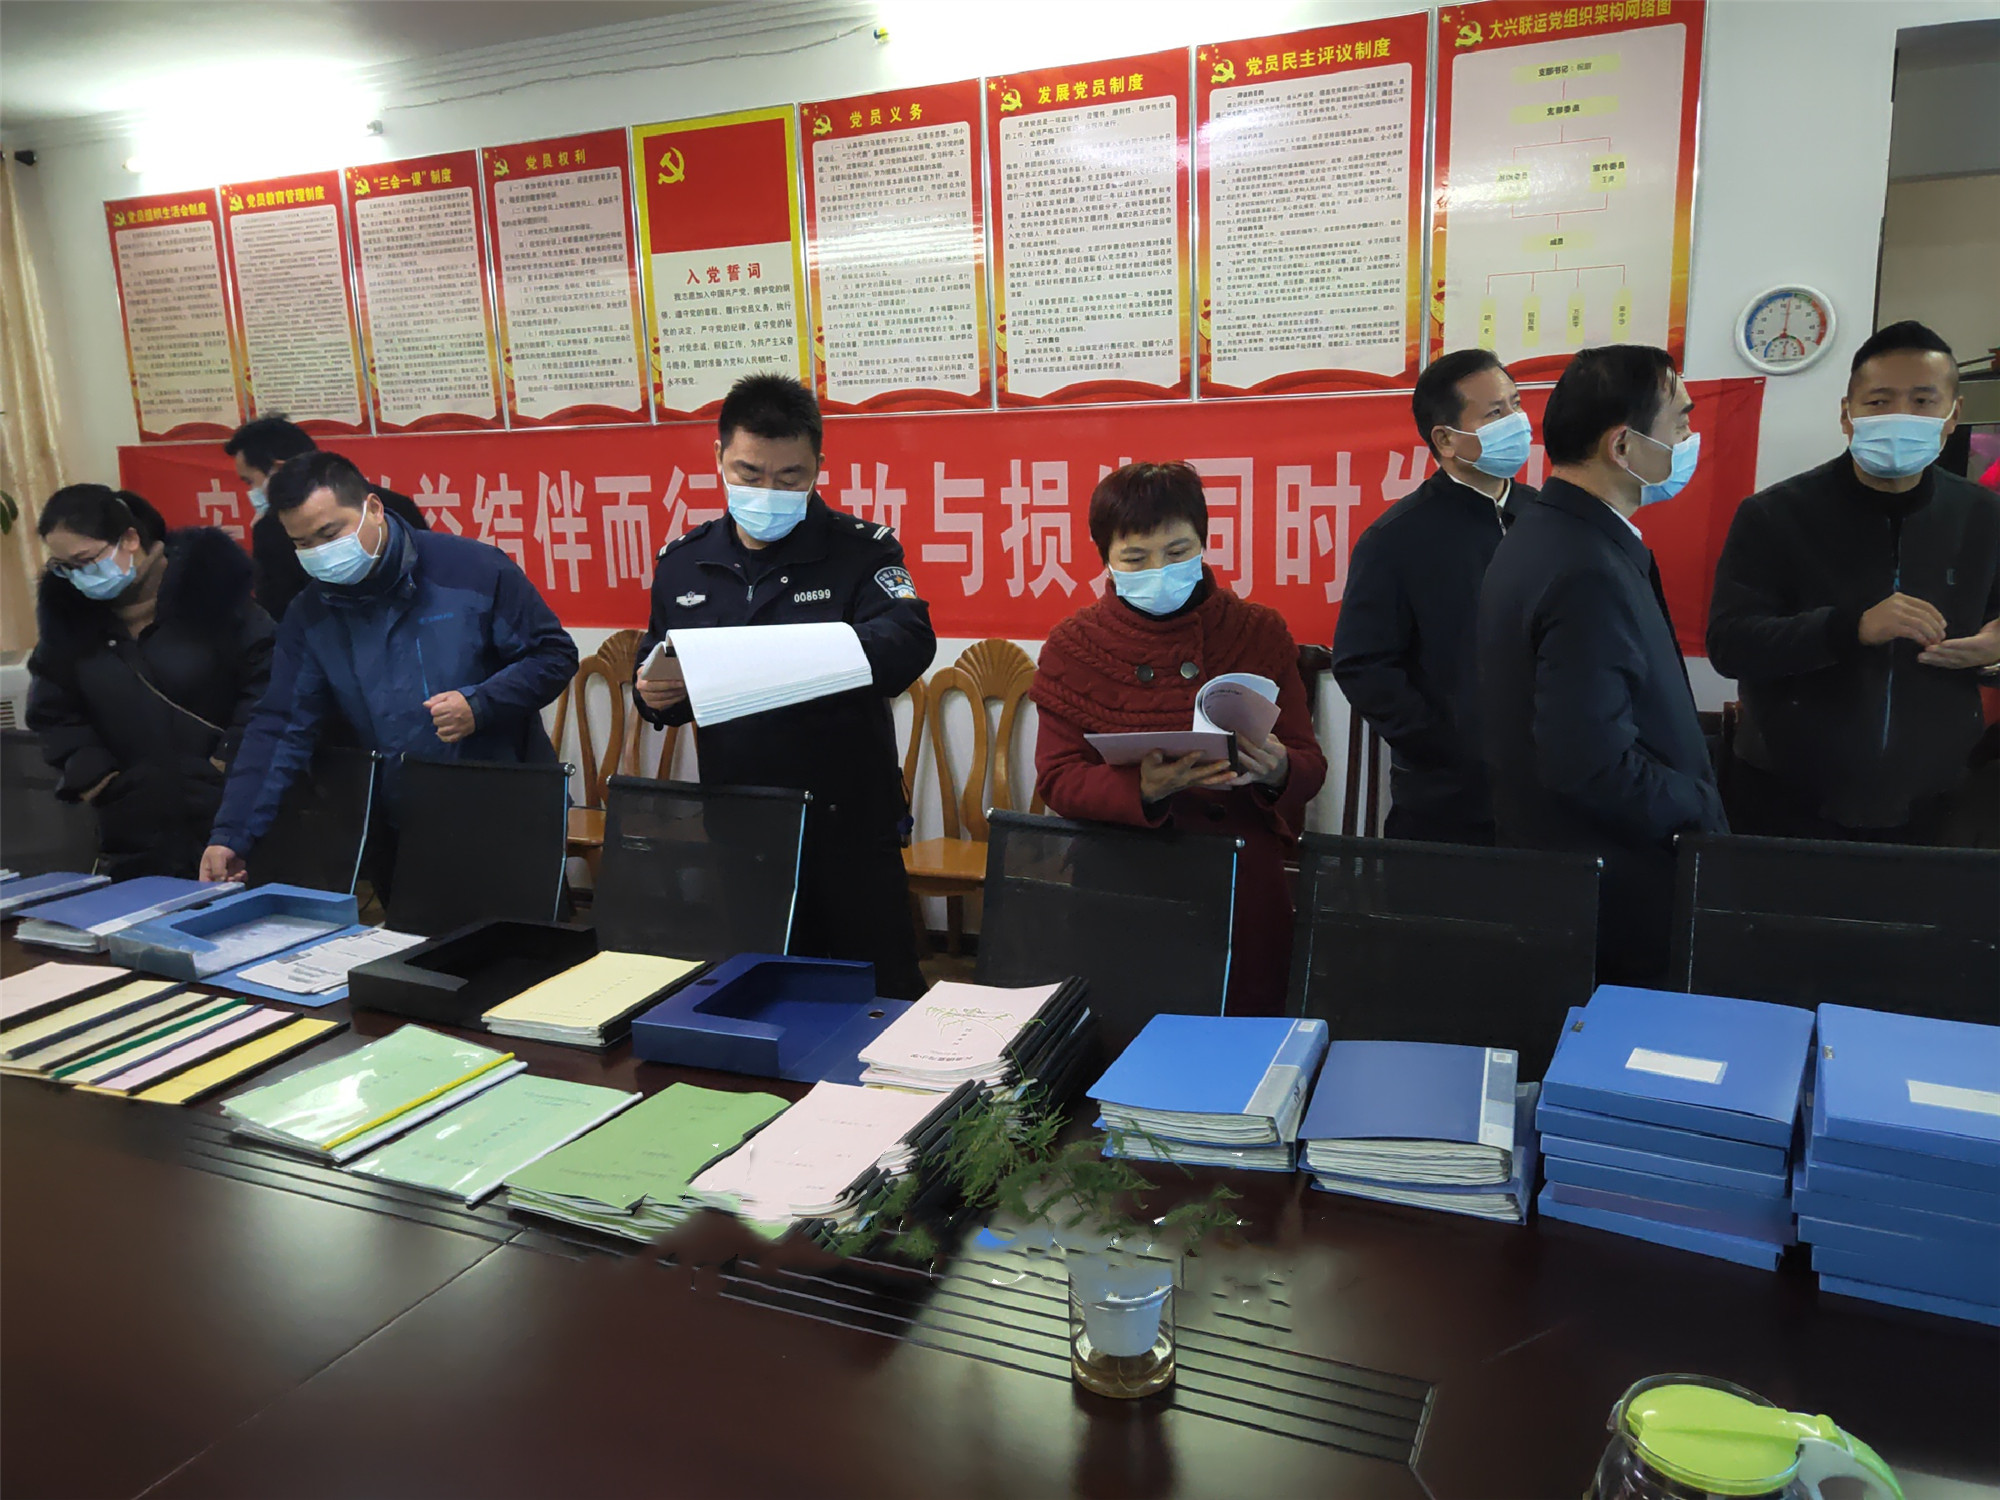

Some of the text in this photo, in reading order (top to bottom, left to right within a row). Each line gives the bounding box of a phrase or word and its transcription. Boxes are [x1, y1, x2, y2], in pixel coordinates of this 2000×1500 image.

[1246, 37, 1391, 77] 党员民主评议制度
[1038, 73, 1144, 104] 发展党员制度
[850, 103, 923, 128] 党员义务
[525, 149, 587, 171] 党员权利
[373, 168, 452, 191] “三会一课”制度
[246, 185, 325, 209] 党员教育管理制度
[687, 263, 761, 284] 入党誓词
[793, 588, 831, 603] 008699
